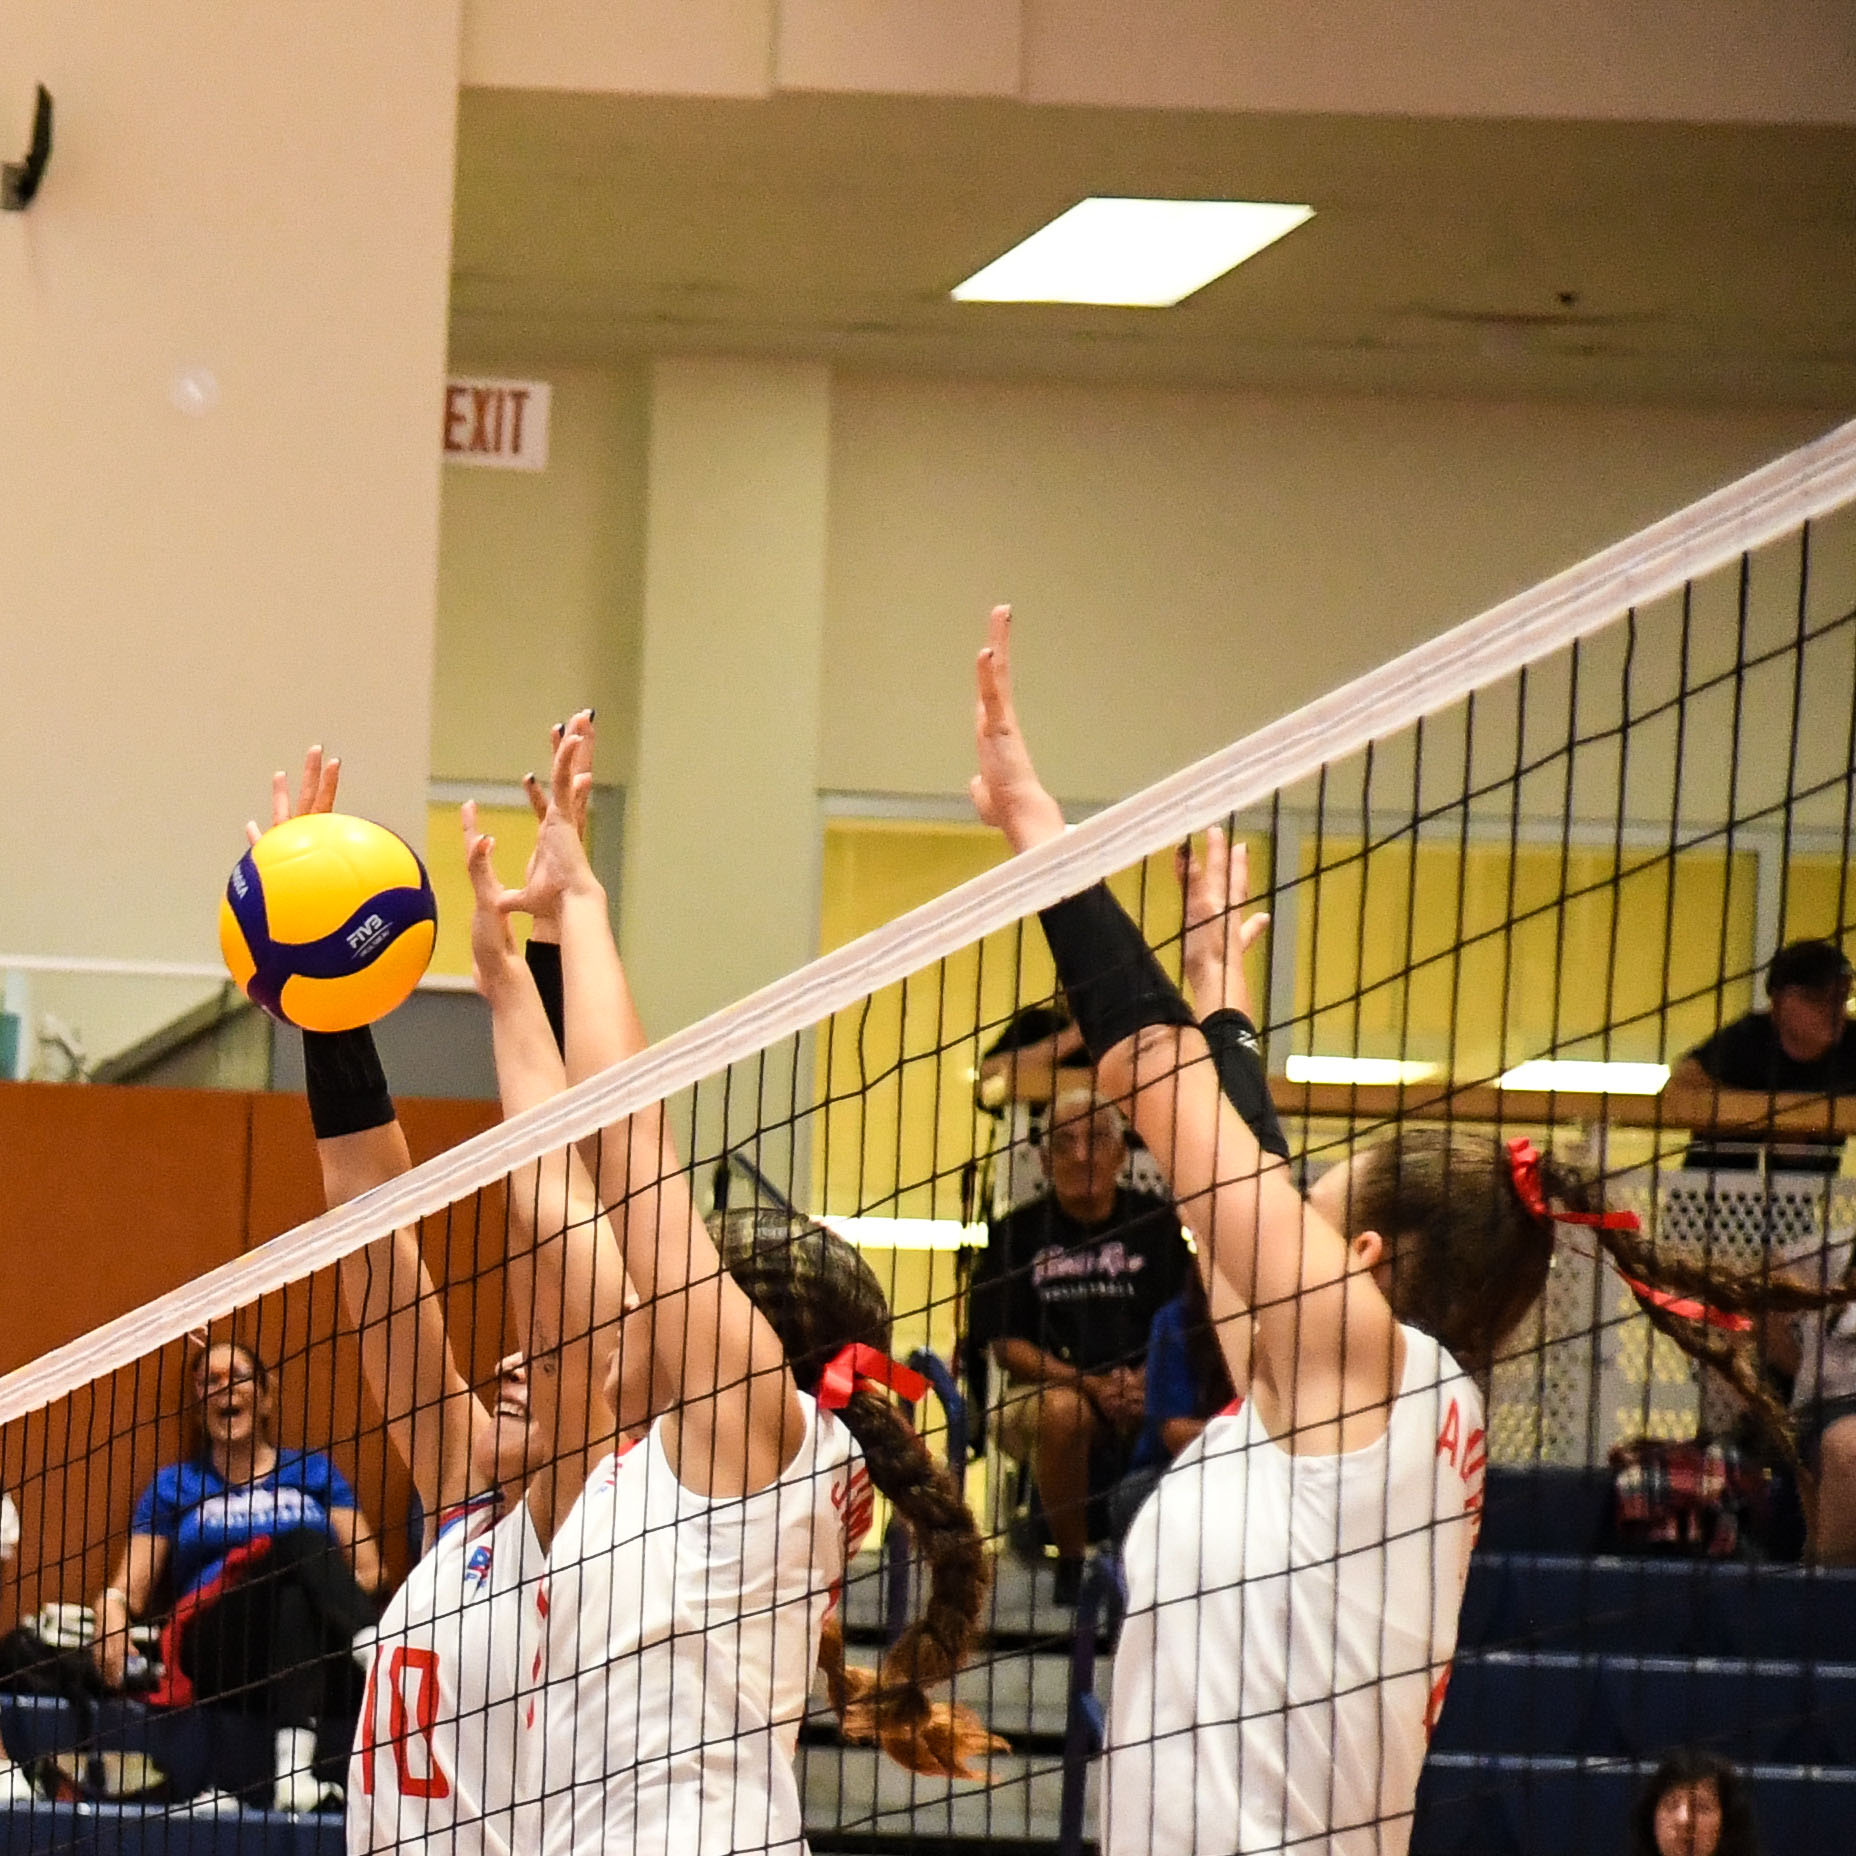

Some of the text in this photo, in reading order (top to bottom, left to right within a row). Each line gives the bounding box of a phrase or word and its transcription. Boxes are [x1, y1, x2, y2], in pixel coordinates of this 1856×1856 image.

[444, 385, 530, 454] EXIT
[346, 913, 383, 949] FIVB
[363, 1645, 450, 1798] 10
